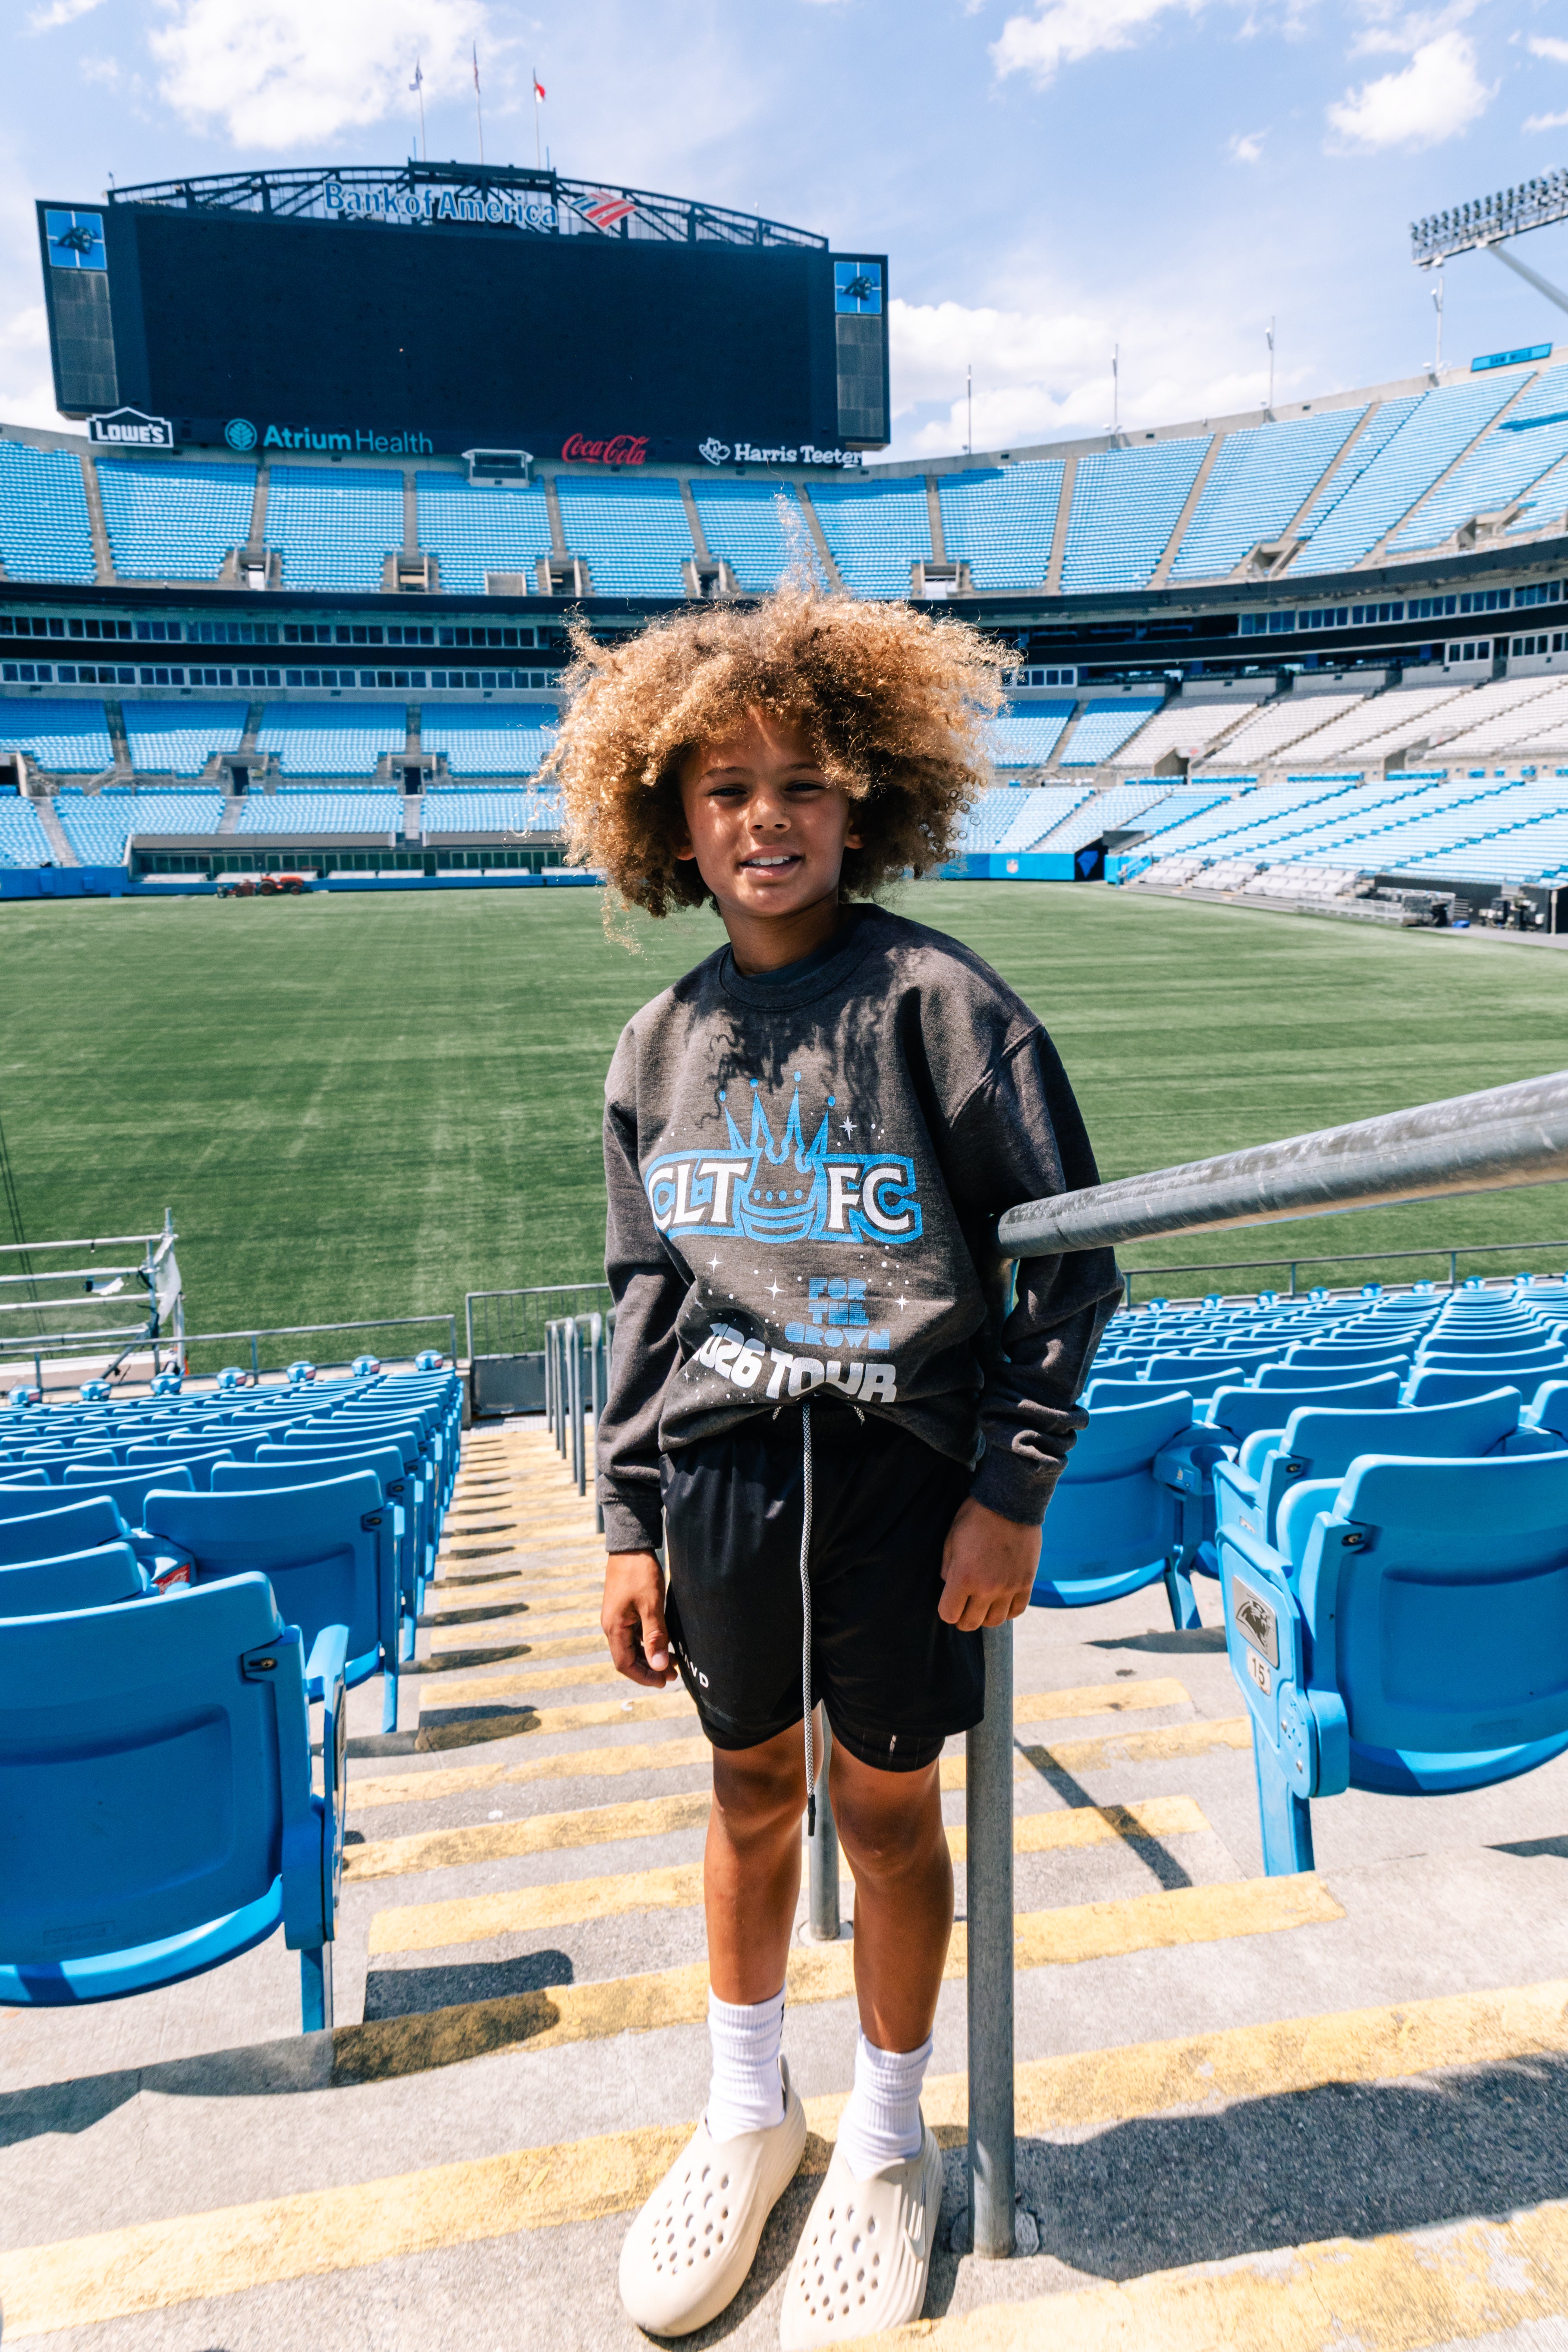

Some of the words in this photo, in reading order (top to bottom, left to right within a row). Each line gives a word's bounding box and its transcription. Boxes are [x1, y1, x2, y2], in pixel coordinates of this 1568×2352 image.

[323, 180, 399, 215] Bank
[404, 189, 433, 218] of
[437, 190, 558, 227] America
[95, 421, 165, 444] LOWE'S
[263, 424, 352, 451] Atrium
[355, 429, 434, 454] Health
[734, 443, 798, 462] Harris
[800, 445, 862, 465] Teeter
[648, 1162, 748, 1230] CLT
[827, 1167, 910, 1231] FC
[809, 1278, 867, 1300] FOR
[784, 1322, 890, 1350] CROWN
[766, 1347, 897, 1403] TOUR
[1252, 1658, 1265, 1685] 15
